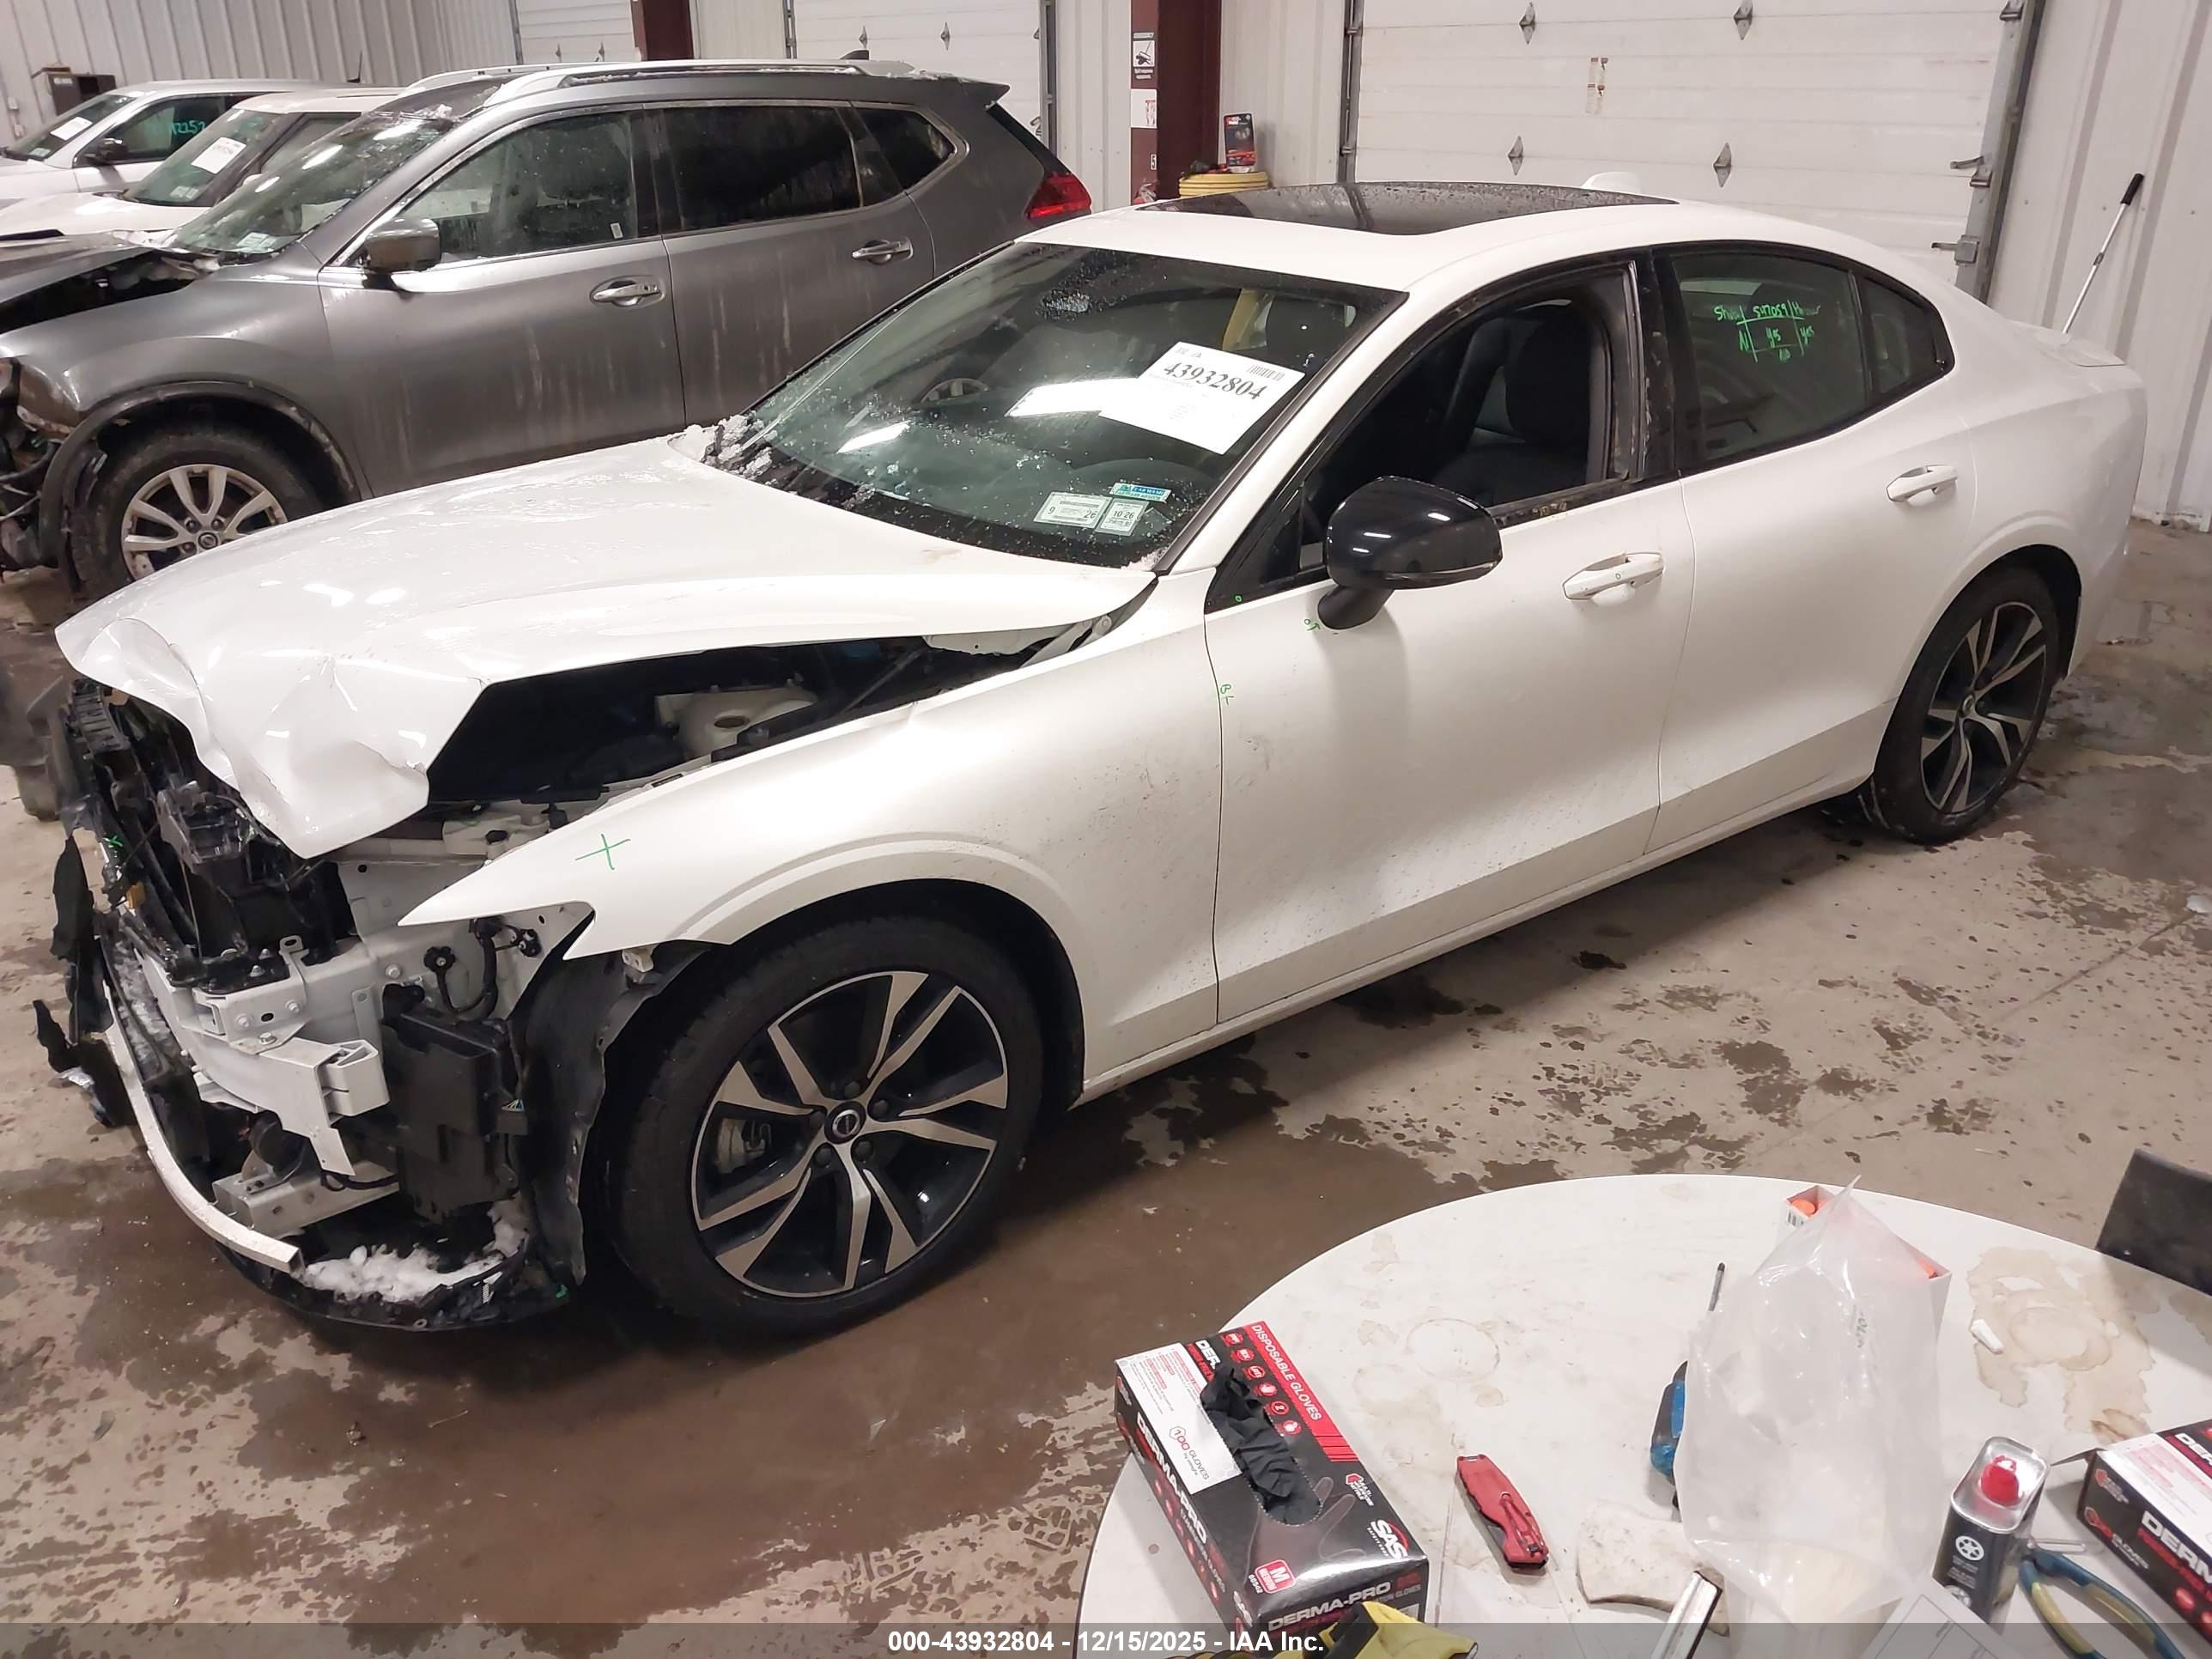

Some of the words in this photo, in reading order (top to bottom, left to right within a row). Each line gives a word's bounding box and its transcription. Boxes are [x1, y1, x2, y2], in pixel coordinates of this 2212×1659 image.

[1163, 362, 1268, 400] 43932804
[1251, 1325, 1296, 1382] DISPOSABLE
[1290, 1382, 1322, 1420] GLOVES
[1174, 1428, 1190, 1451] 100
[1188, 1449, 1210, 1480] GLOVES
[1370, 1519, 1407, 1559] SAS
[1269, 1565, 1287, 1583] M
[1268, 1582, 1391, 1632] DERMA-PRO
